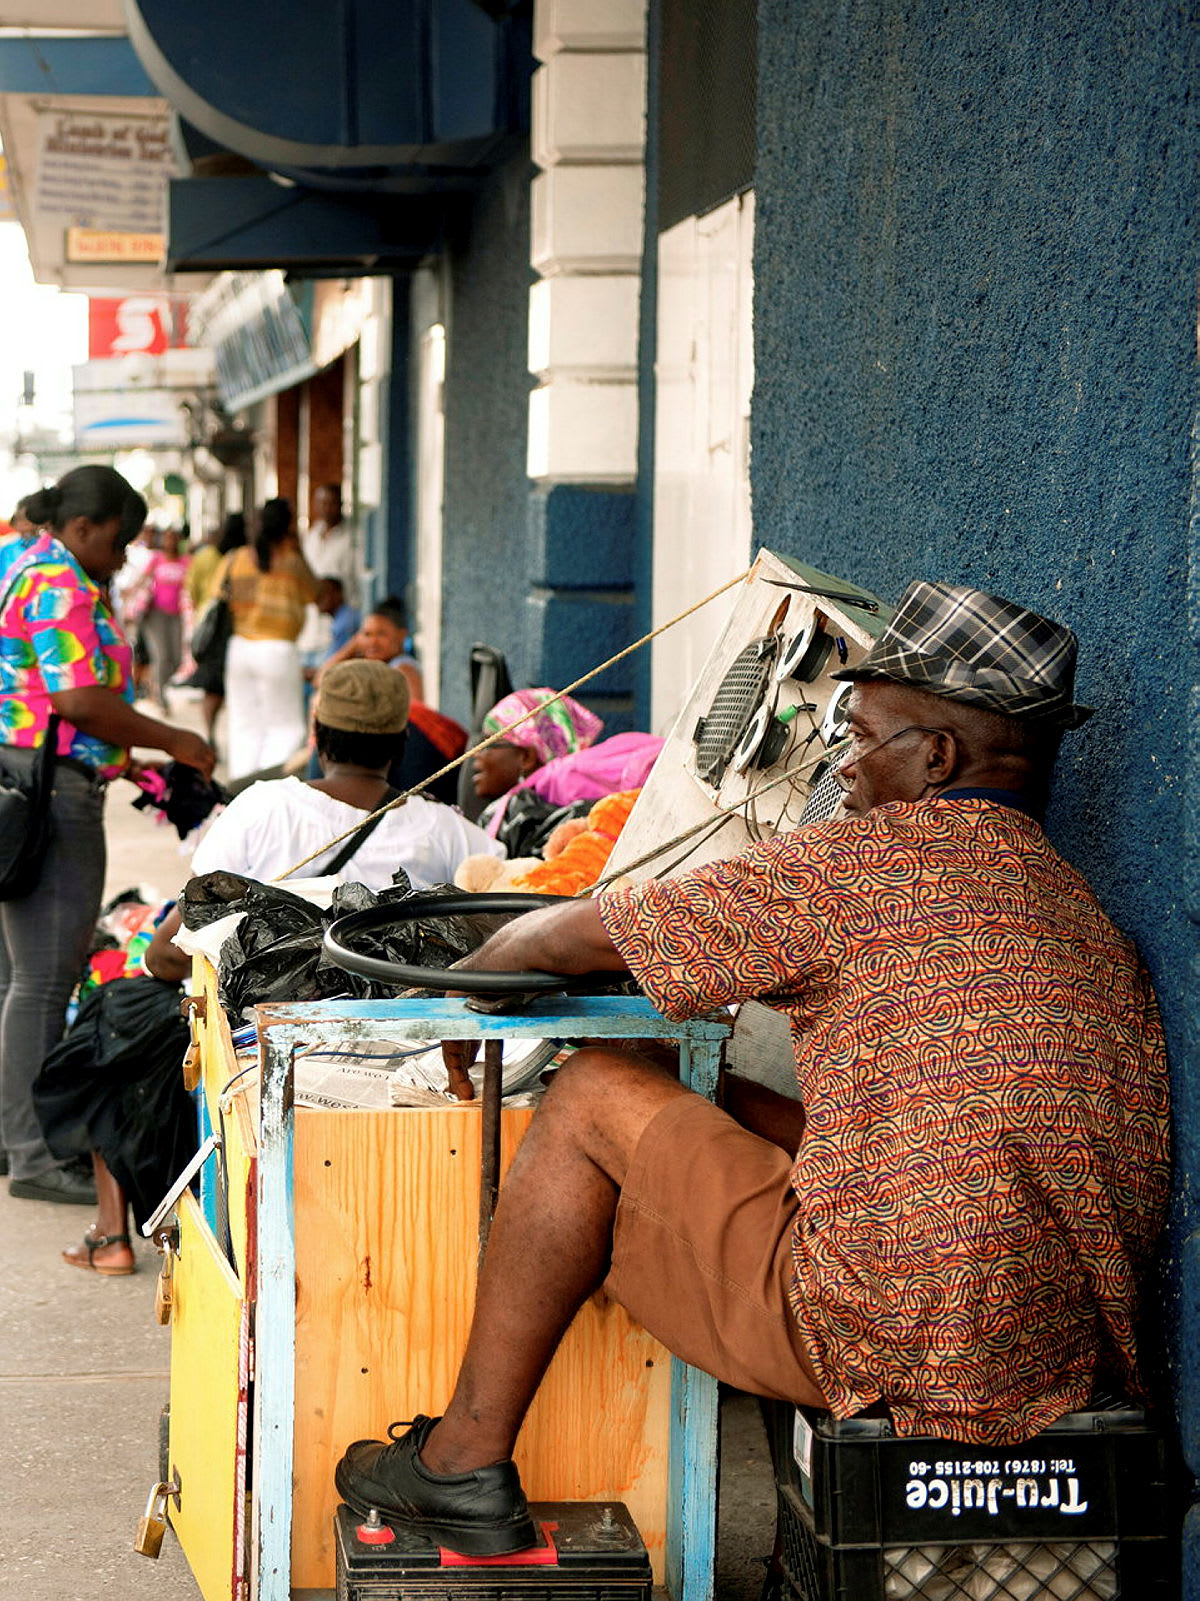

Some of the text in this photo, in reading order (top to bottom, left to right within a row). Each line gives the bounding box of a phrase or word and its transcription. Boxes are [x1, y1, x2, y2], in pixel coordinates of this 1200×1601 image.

[934, 1460, 1001, 1476] 708-2155
[1004, 1459, 1047, 1474] (876)
[1050, 1459, 1077, 1473] Tel:
[905, 1478, 1088, 1516] Tru-Juice
